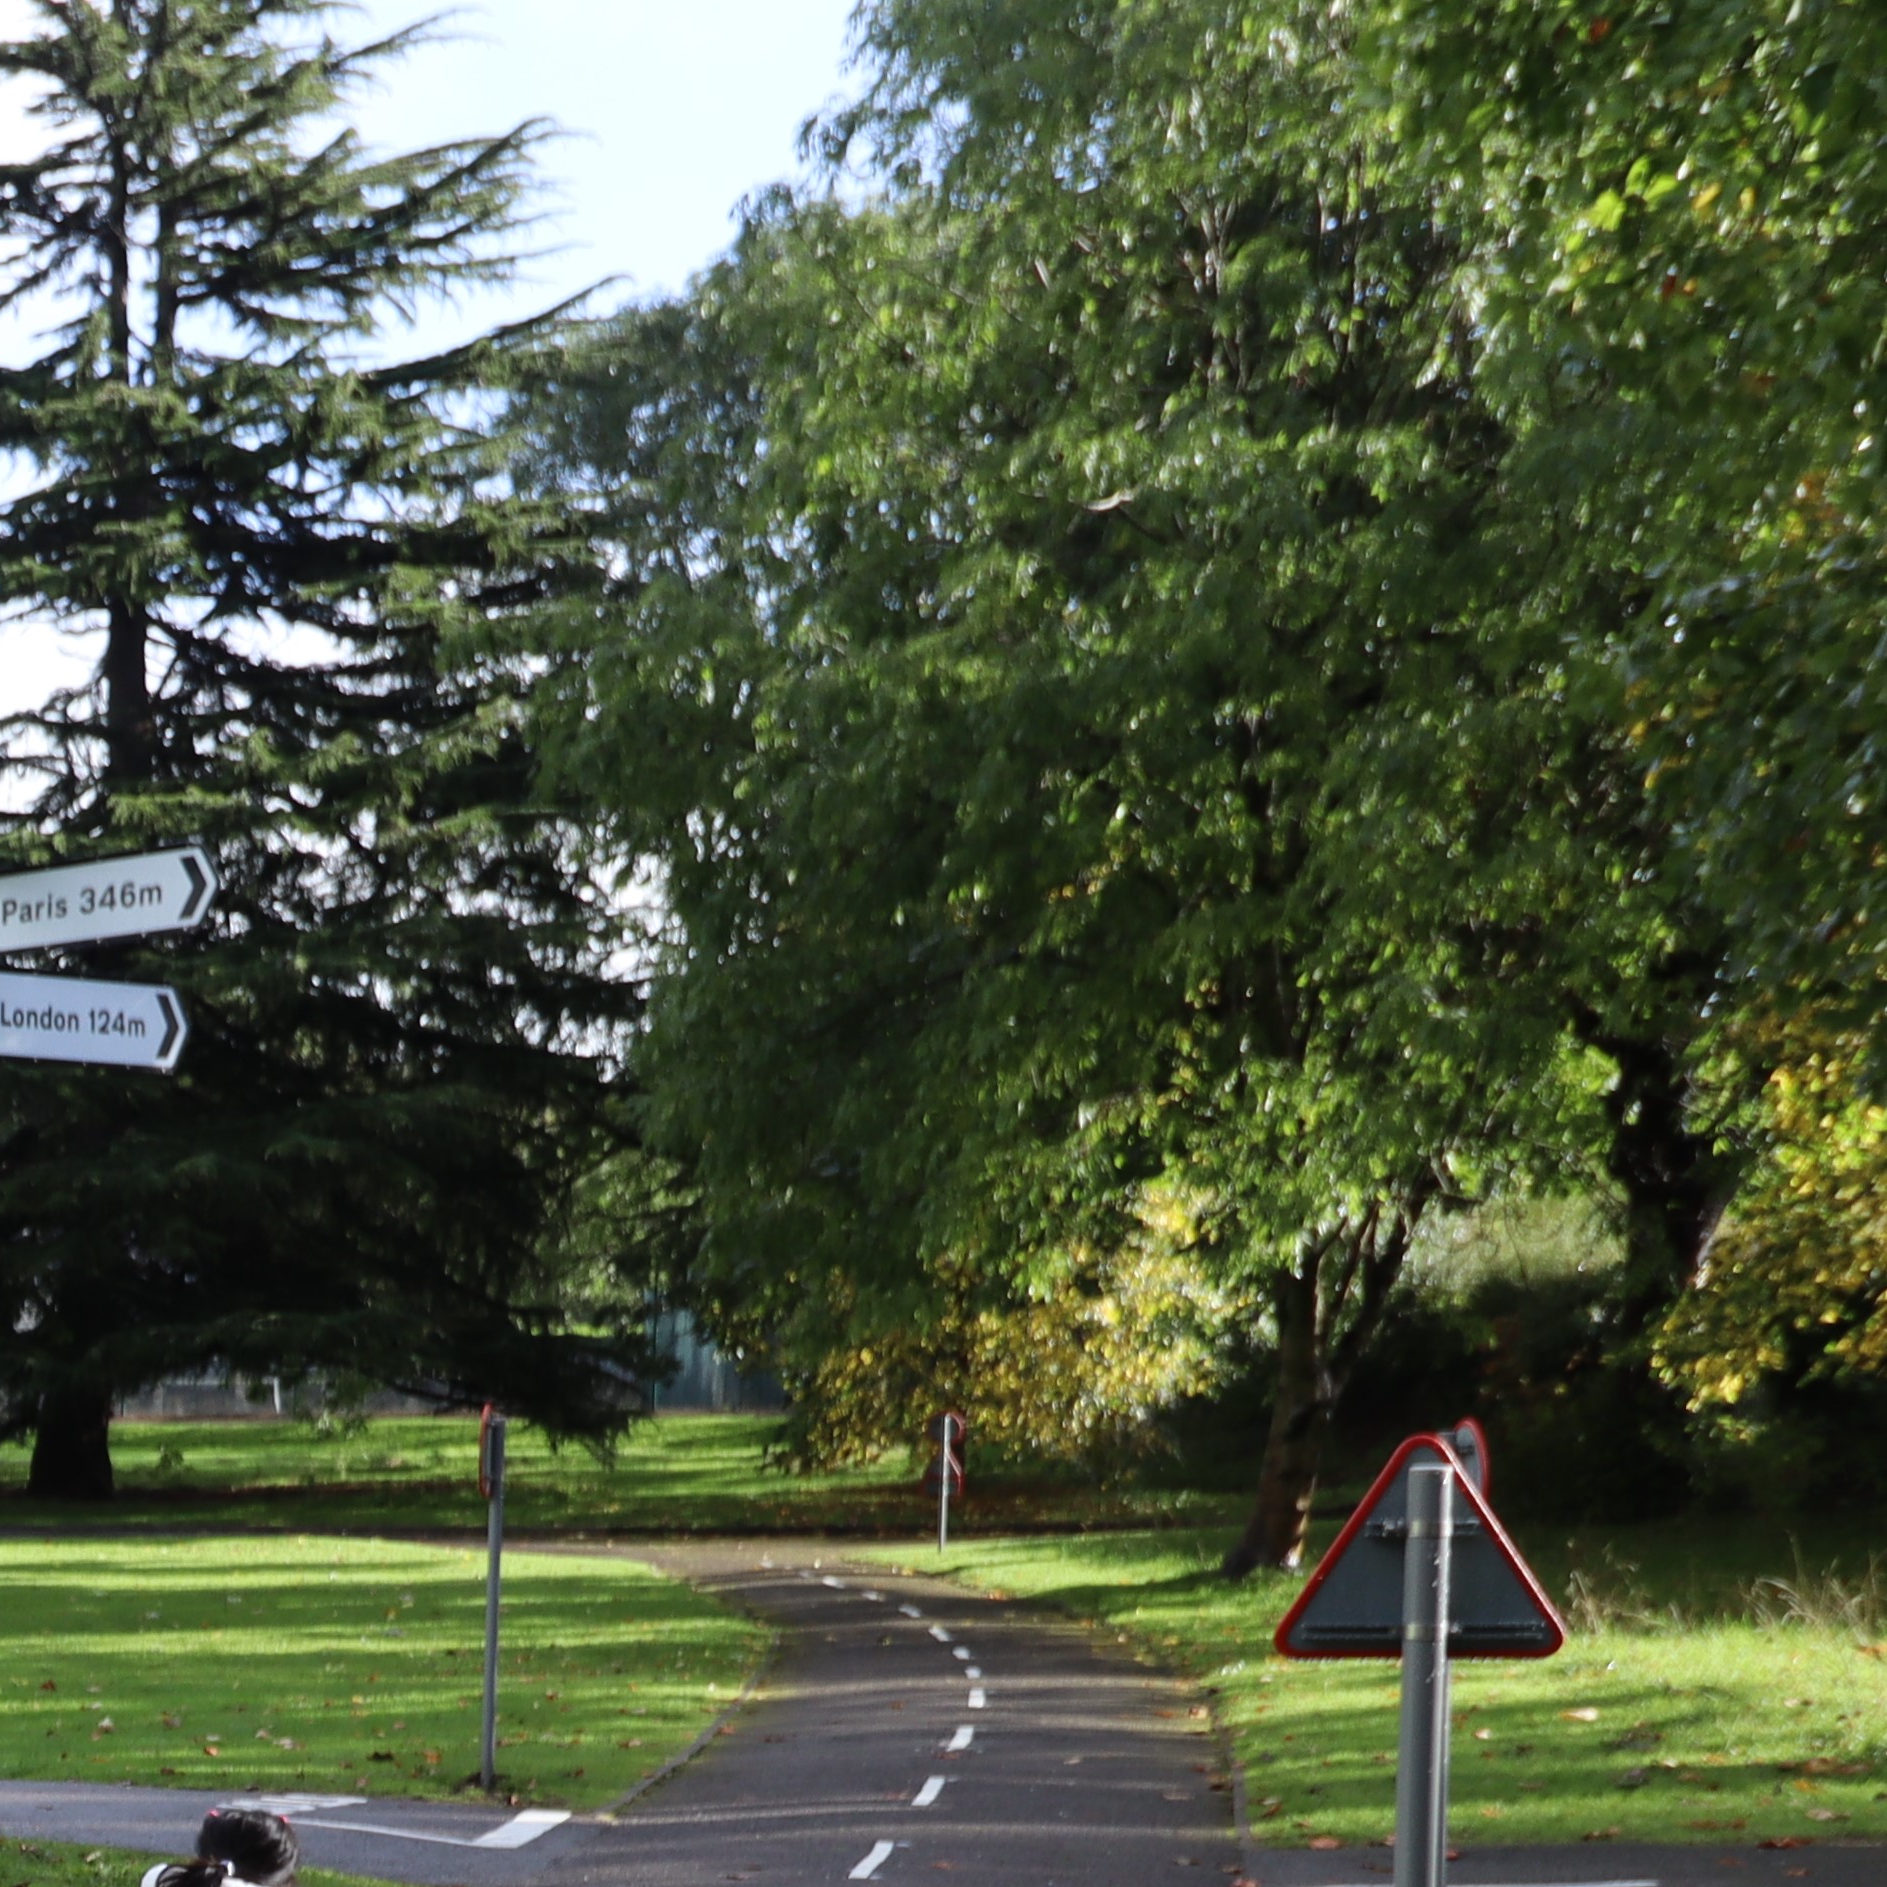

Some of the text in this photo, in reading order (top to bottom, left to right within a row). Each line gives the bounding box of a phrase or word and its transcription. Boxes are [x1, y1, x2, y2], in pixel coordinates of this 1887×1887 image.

[1, 881, 163, 926] Paris 346m
[0, 1001, 146, 1038] London 124m
